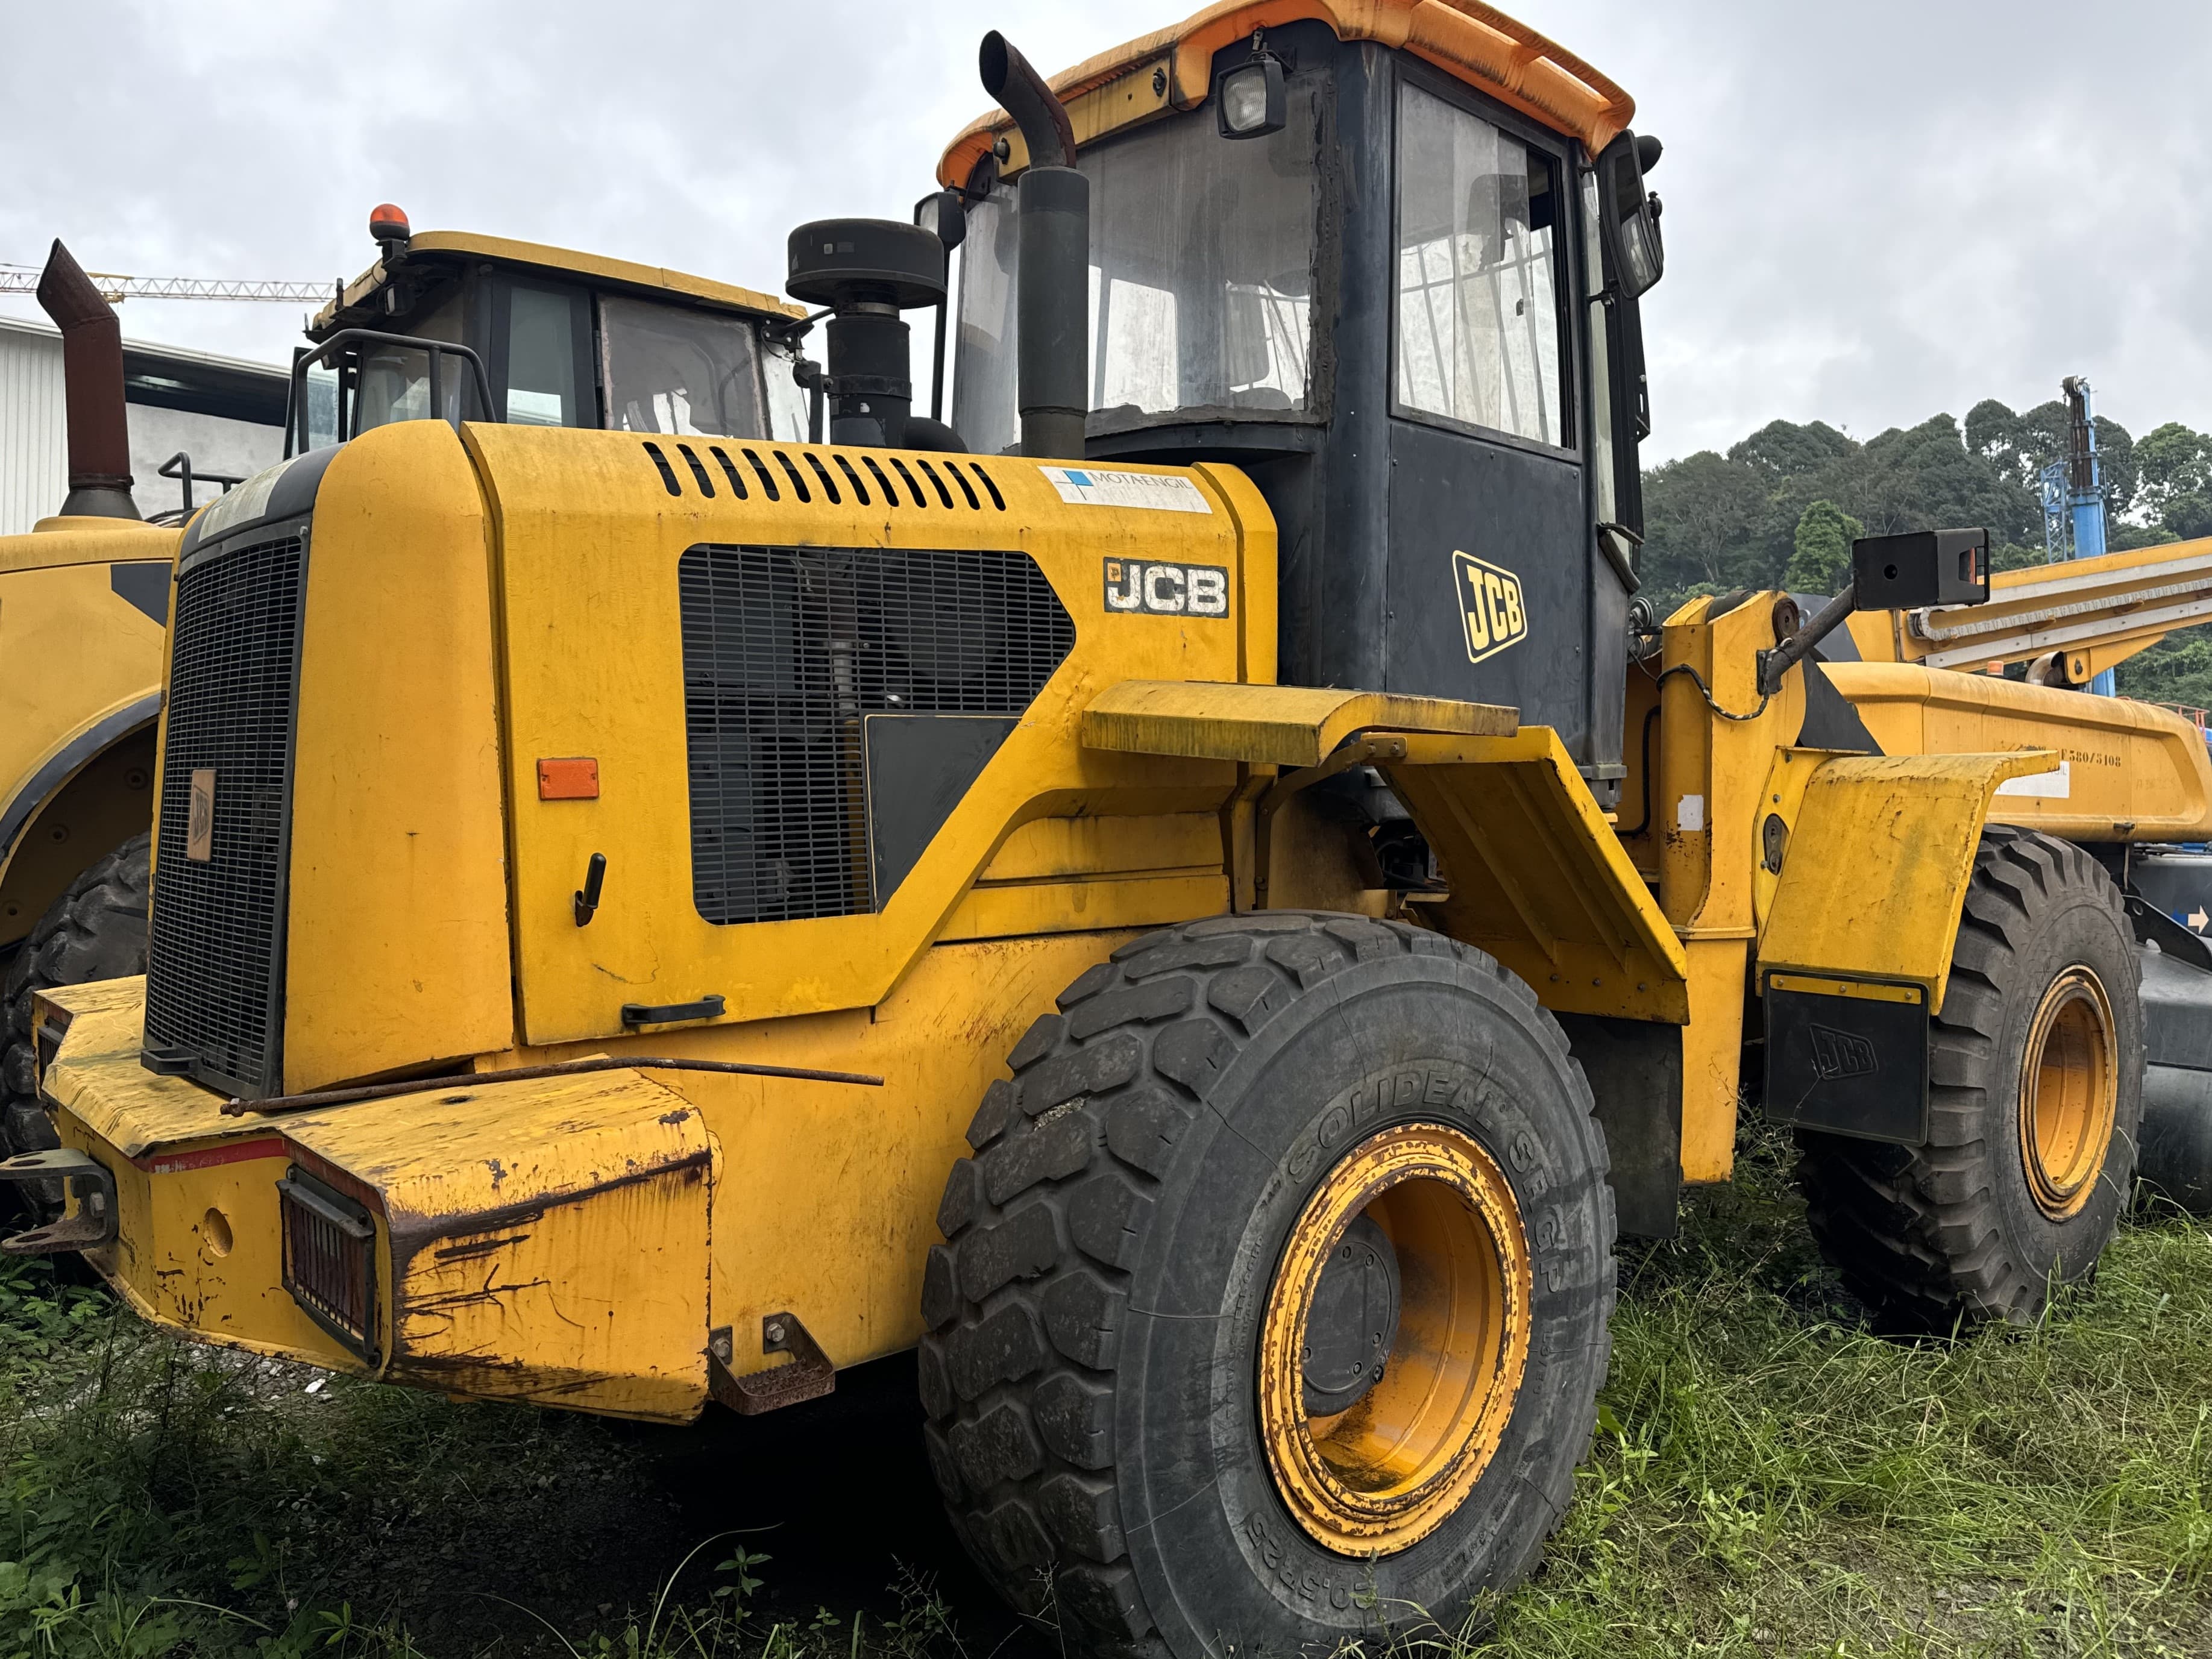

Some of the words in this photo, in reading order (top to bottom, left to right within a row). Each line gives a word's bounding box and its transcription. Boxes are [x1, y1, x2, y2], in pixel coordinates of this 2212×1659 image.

[1107, 564, 1226, 614] JCB
[1466, 564, 1522, 650] JCB
[1820, 1030, 1874, 1075] JCB
[1288, 1069, 1495, 1184] SOLIDEAL
